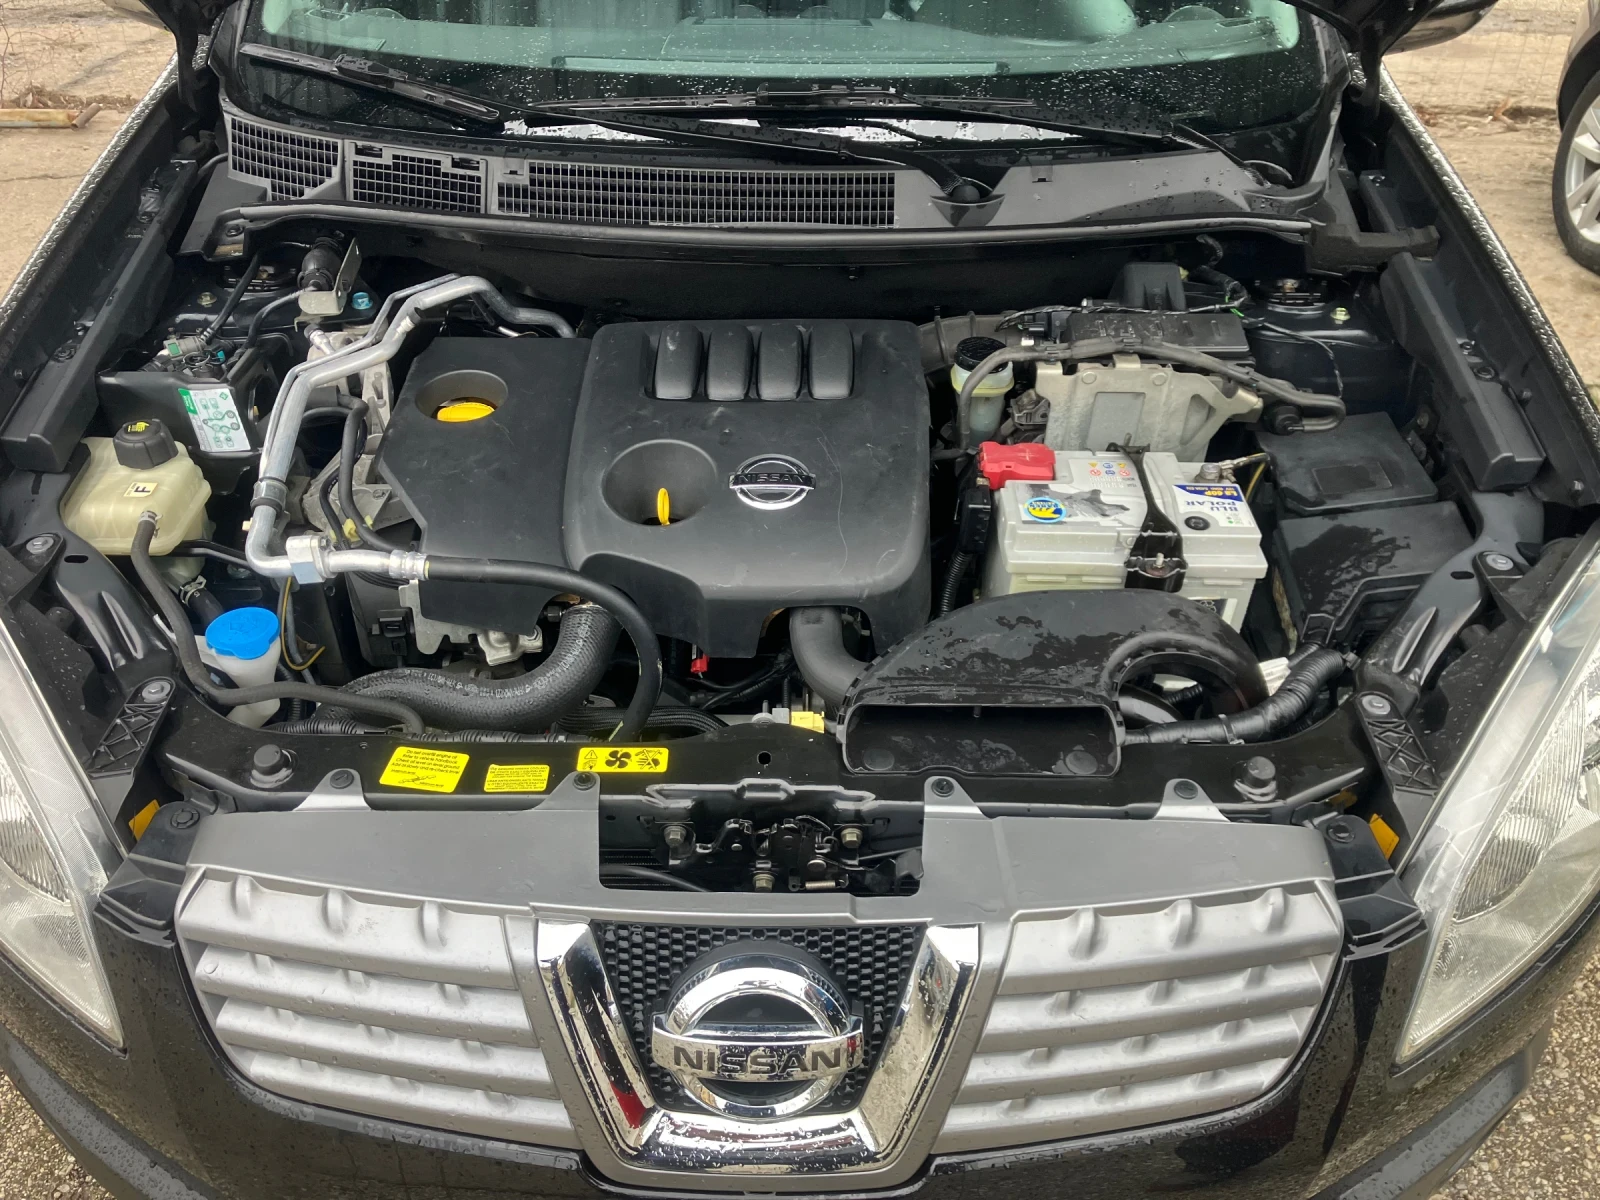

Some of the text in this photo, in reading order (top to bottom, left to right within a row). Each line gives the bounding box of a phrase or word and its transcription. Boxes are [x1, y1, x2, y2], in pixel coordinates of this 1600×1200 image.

[739, 473, 805, 483] NISSAN
[134, 485, 151, 493] F
[673, 1045, 841, 1075] NISSAN
